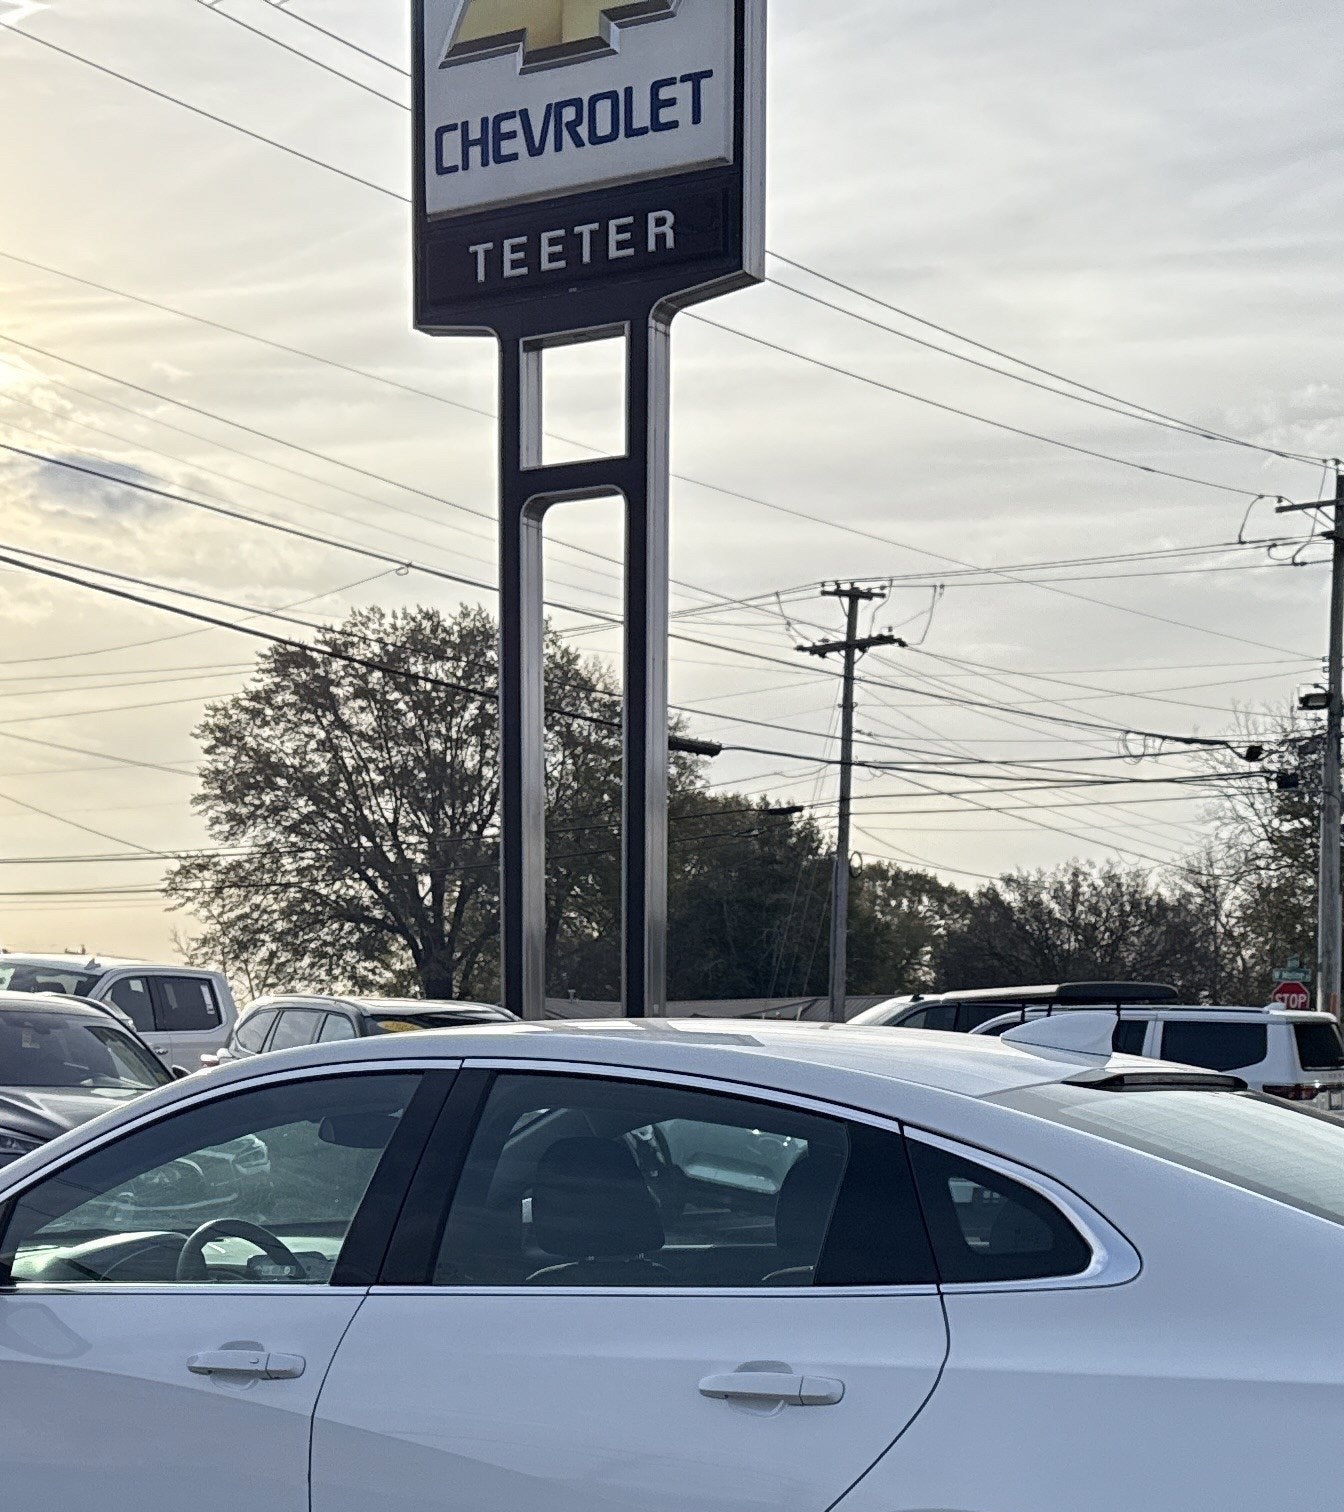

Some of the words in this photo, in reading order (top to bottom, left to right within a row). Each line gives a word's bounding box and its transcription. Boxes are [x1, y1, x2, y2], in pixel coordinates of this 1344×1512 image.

[435, 69, 714, 176] CHEVROLET
[469, 210, 675, 283] TEETER
[1275, 993, 1307, 1009] STOP
